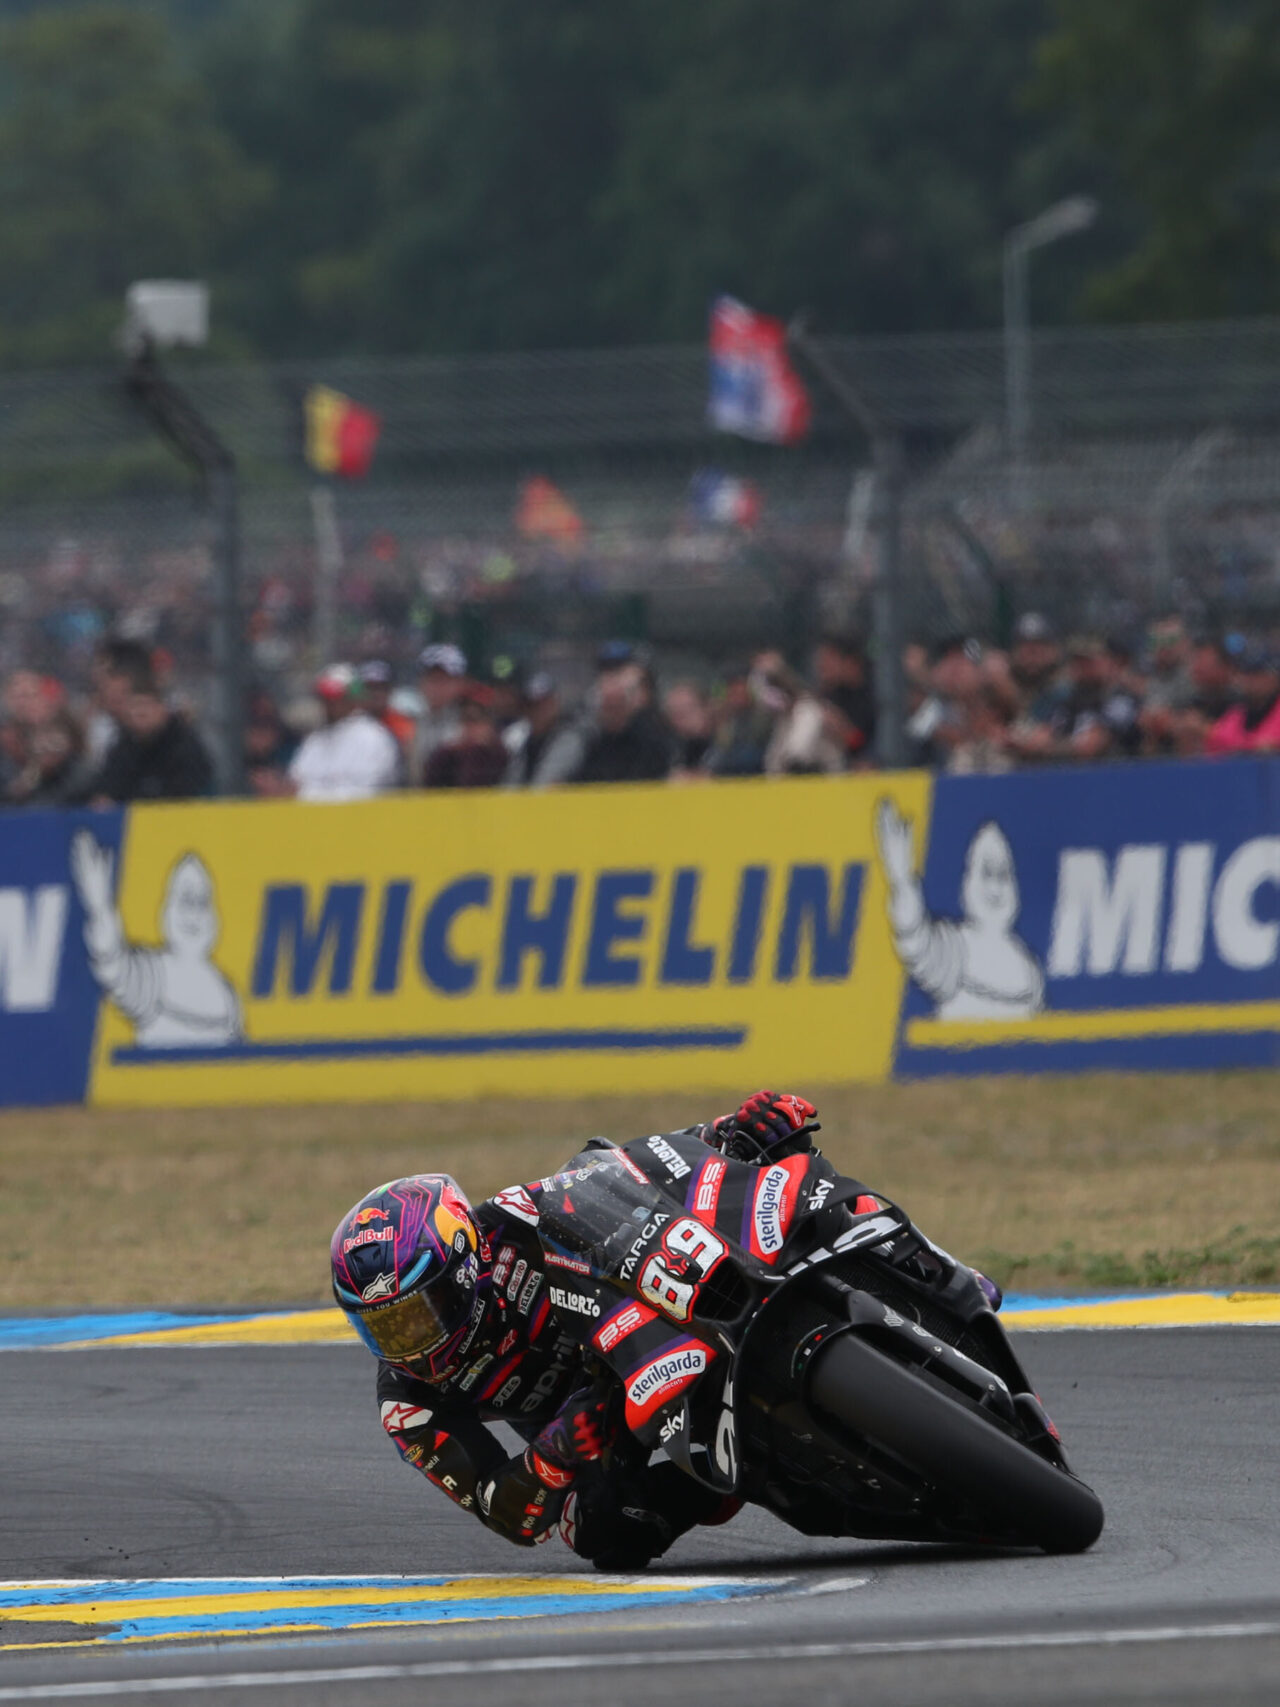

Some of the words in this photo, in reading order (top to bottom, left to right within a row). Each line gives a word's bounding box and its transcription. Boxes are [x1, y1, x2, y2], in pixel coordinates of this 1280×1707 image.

[252, 865, 865, 995] MICHELIN
[696, 1162, 721, 1210] BS
[808, 1178, 835, 1210] sky
[756, 1170, 784, 1249] sterilgarda
[363, 1225, 394, 1243] Bull
[620, 1212, 670, 1280] TARGA
[492, 1246, 512, 1285] BS
[509, 1261, 525, 1293] Castrol
[637, 1216, 729, 1323] 89
[598, 1306, 640, 1348] BS
[631, 1351, 701, 1400] sterilgarda
[660, 1409, 685, 1443] sky
